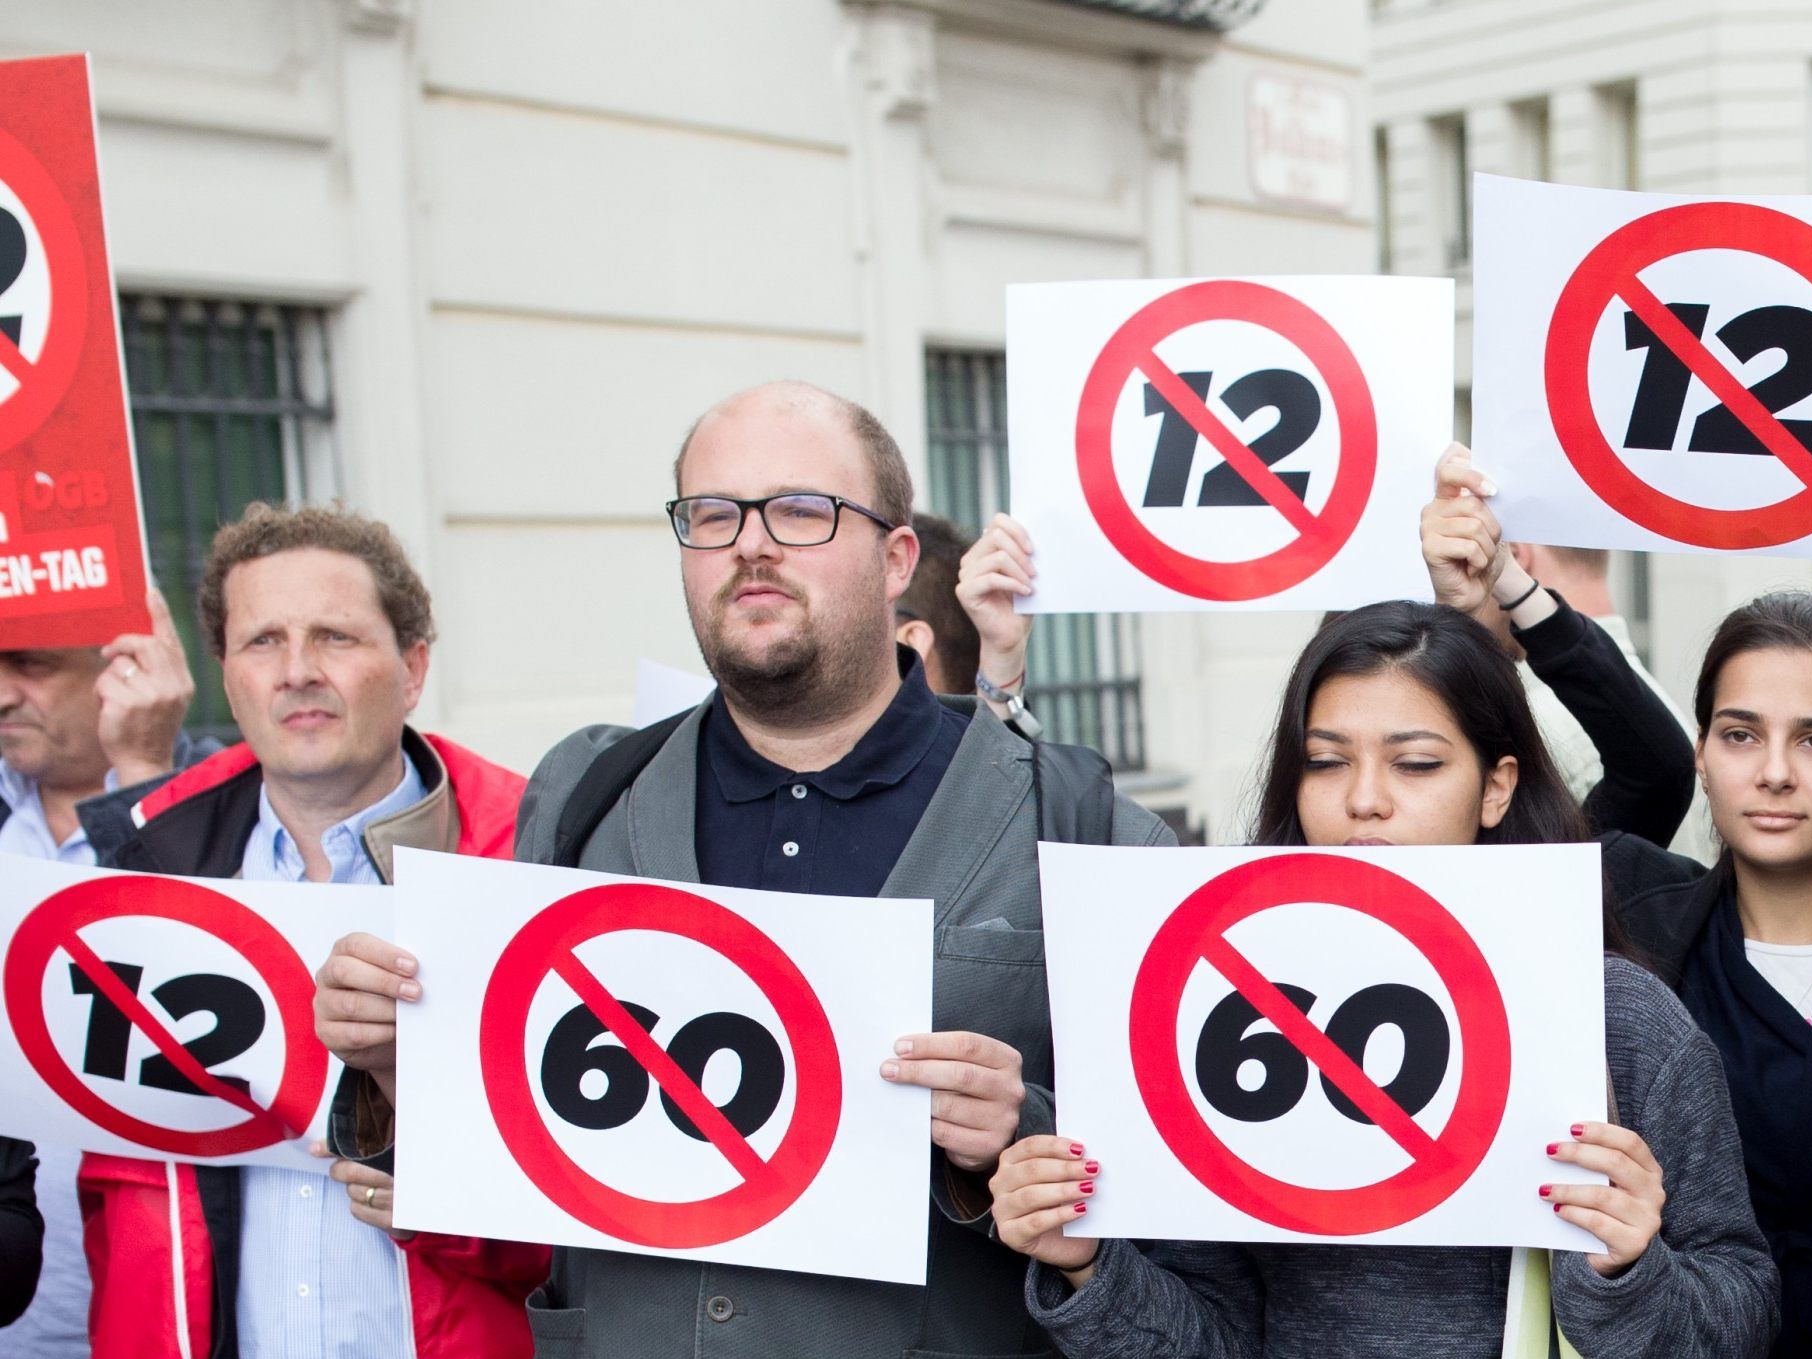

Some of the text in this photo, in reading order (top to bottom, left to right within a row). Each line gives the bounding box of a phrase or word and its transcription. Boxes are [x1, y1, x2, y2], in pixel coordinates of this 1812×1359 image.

[1142, 369, 1322, 507] 12
[68, 961, 266, 1098] 12
[540, 1000, 785, 1143] 60
[1195, 982, 1450, 1125] 60
